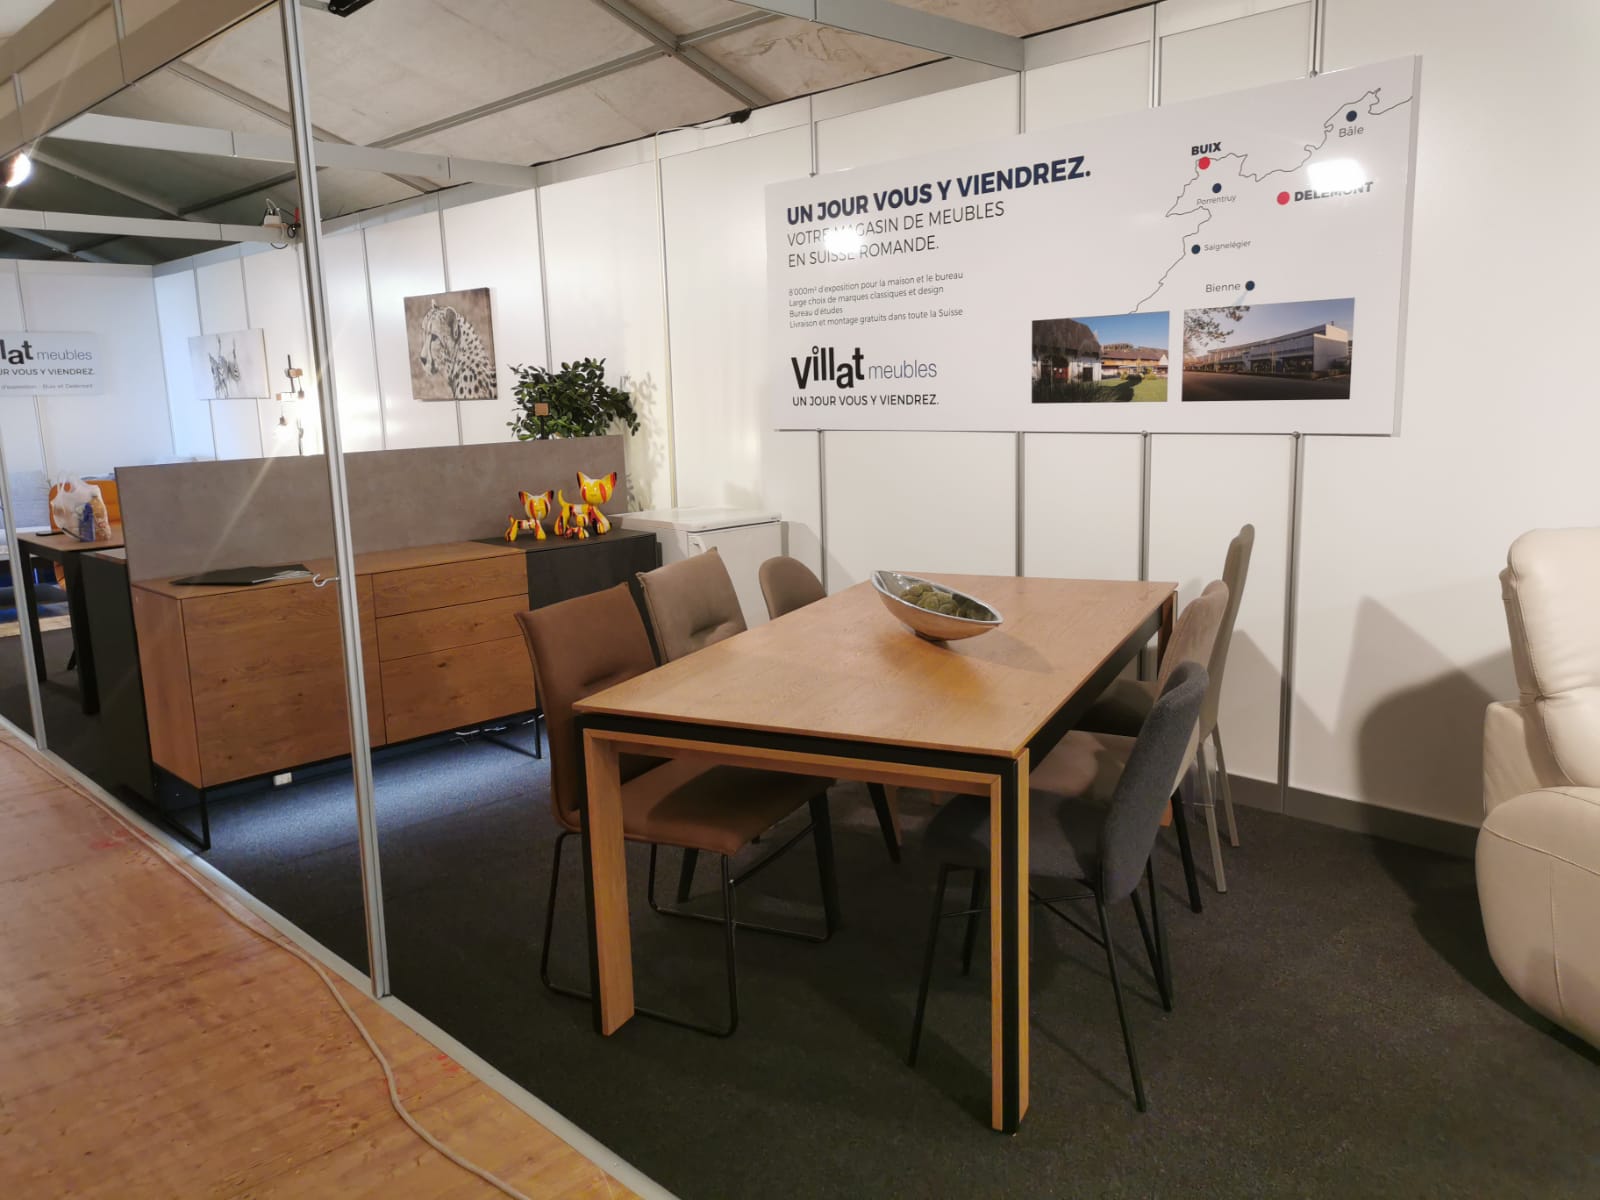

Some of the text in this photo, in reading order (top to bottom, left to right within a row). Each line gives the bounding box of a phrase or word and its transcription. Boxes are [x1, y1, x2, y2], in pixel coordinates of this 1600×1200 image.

[1338, 125, 1364, 138] Bâle
[1191, 142, 1222, 156] BUIX
[786, 155, 1092, 225] UN JOUR VOUS Y VIENDREZ.
[1196, 195, 1237, 205] Porrentruy
[834, 216, 898, 239] GASIN
[903, 213, 924, 230] DE
[928, 200, 1005, 227] MEUBLES
[788, 252, 806, 268] EN
[859, 234, 939, 259] ROMANDE.
[1204, 240, 1251, 251] Saignelégier
[861, 281, 878, 290] pour
[879, 278, 886, 287] la
[887, 276, 915, 286] maison
[916, 274, 924, 283] et
[926, 273, 934, 282] le
[935, 271, 964, 282] bureau
[1205, 282, 1241, 293] Bienne
[788, 285, 944, 308] Large choix de marques classiques et design
[789, 319, 818, 329] Livraison
[827, 316, 858, 326] montage
[859, 313, 887, 325] gratuits
[888, 312, 906, 321] dans
[908, 311, 928, 320] toute
[930, 309, 937, 318] la
[938, 307, 964, 318] Suisse
[36, 347, 93, 361] meubles
[11, 368, 39, 376] VOUS
[40, 368, 46, 376] Y
[791, 345, 938, 390] villat meubles
[792, 393, 940, 407] UN JOUR VOUS Y VIENDREZ.
